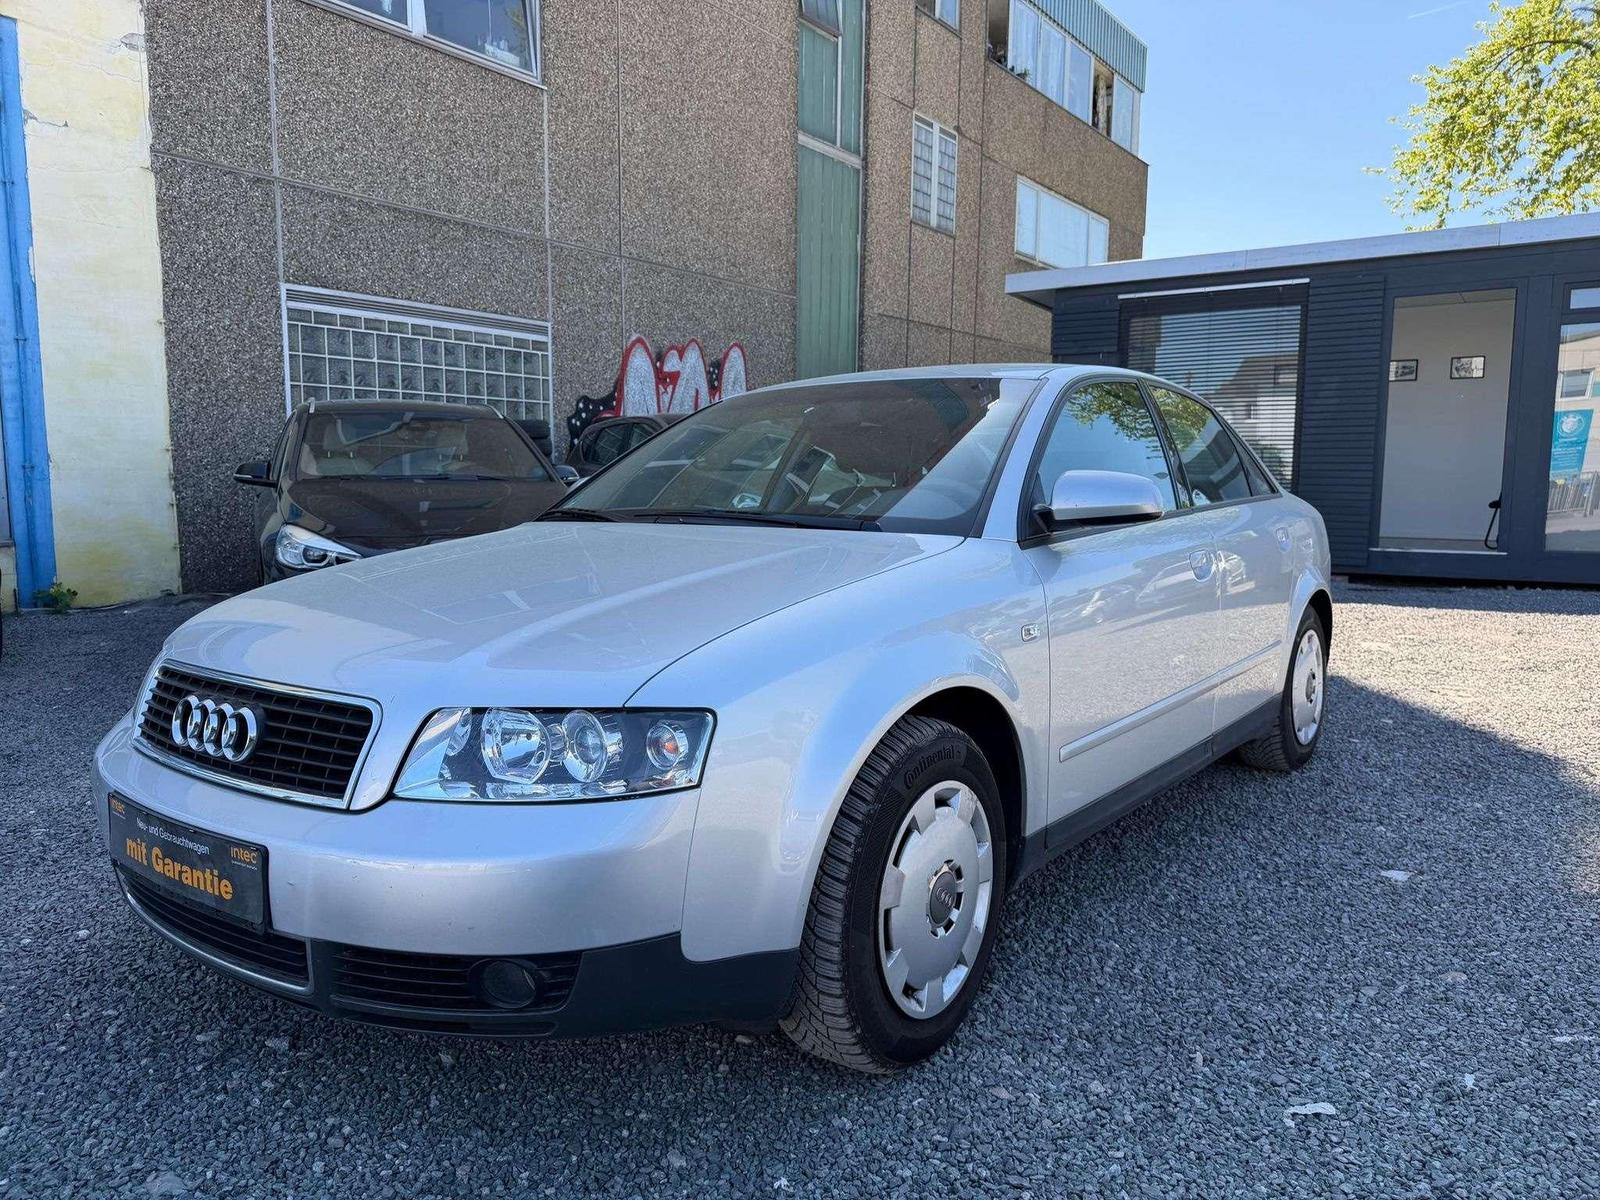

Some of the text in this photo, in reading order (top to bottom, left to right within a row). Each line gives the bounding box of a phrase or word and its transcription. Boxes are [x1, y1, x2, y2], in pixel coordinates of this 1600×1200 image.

[904, 744, 955, 790] Continental
[148, 825, 159, 836] und
[159, 827, 210, 855] Gebrauchtwagen
[230, 845, 257, 864] intec
[126, 838, 233, 900] mit Garantie
